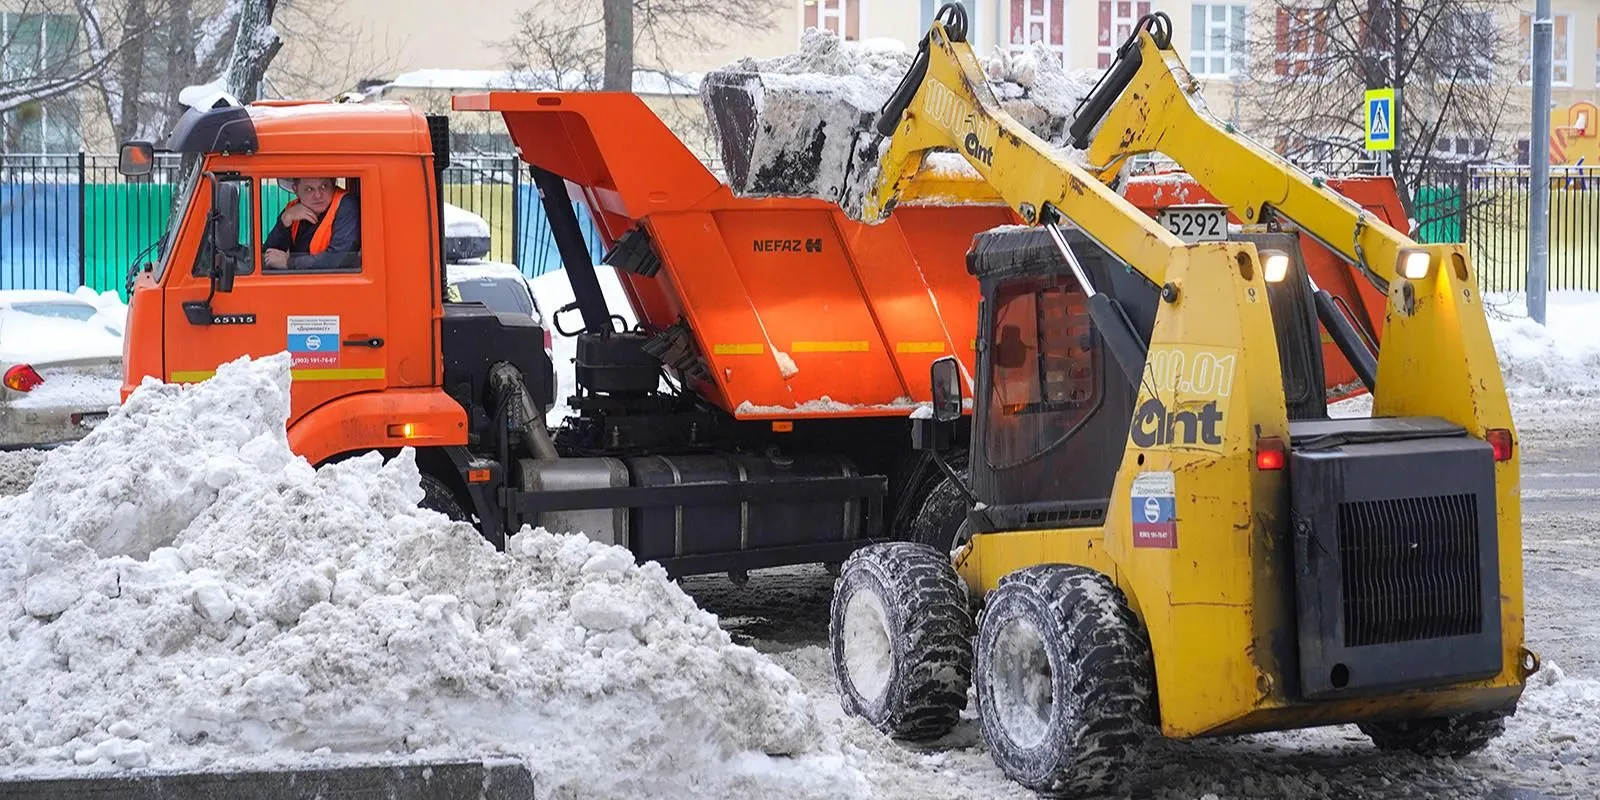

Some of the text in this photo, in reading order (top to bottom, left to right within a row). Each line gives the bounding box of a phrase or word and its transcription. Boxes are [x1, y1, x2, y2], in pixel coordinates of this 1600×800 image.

[1169, 213, 1220, 236] 5292
[753, 239, 802, 252] NEFAZ
[214, 316, 254, 324] 65115
